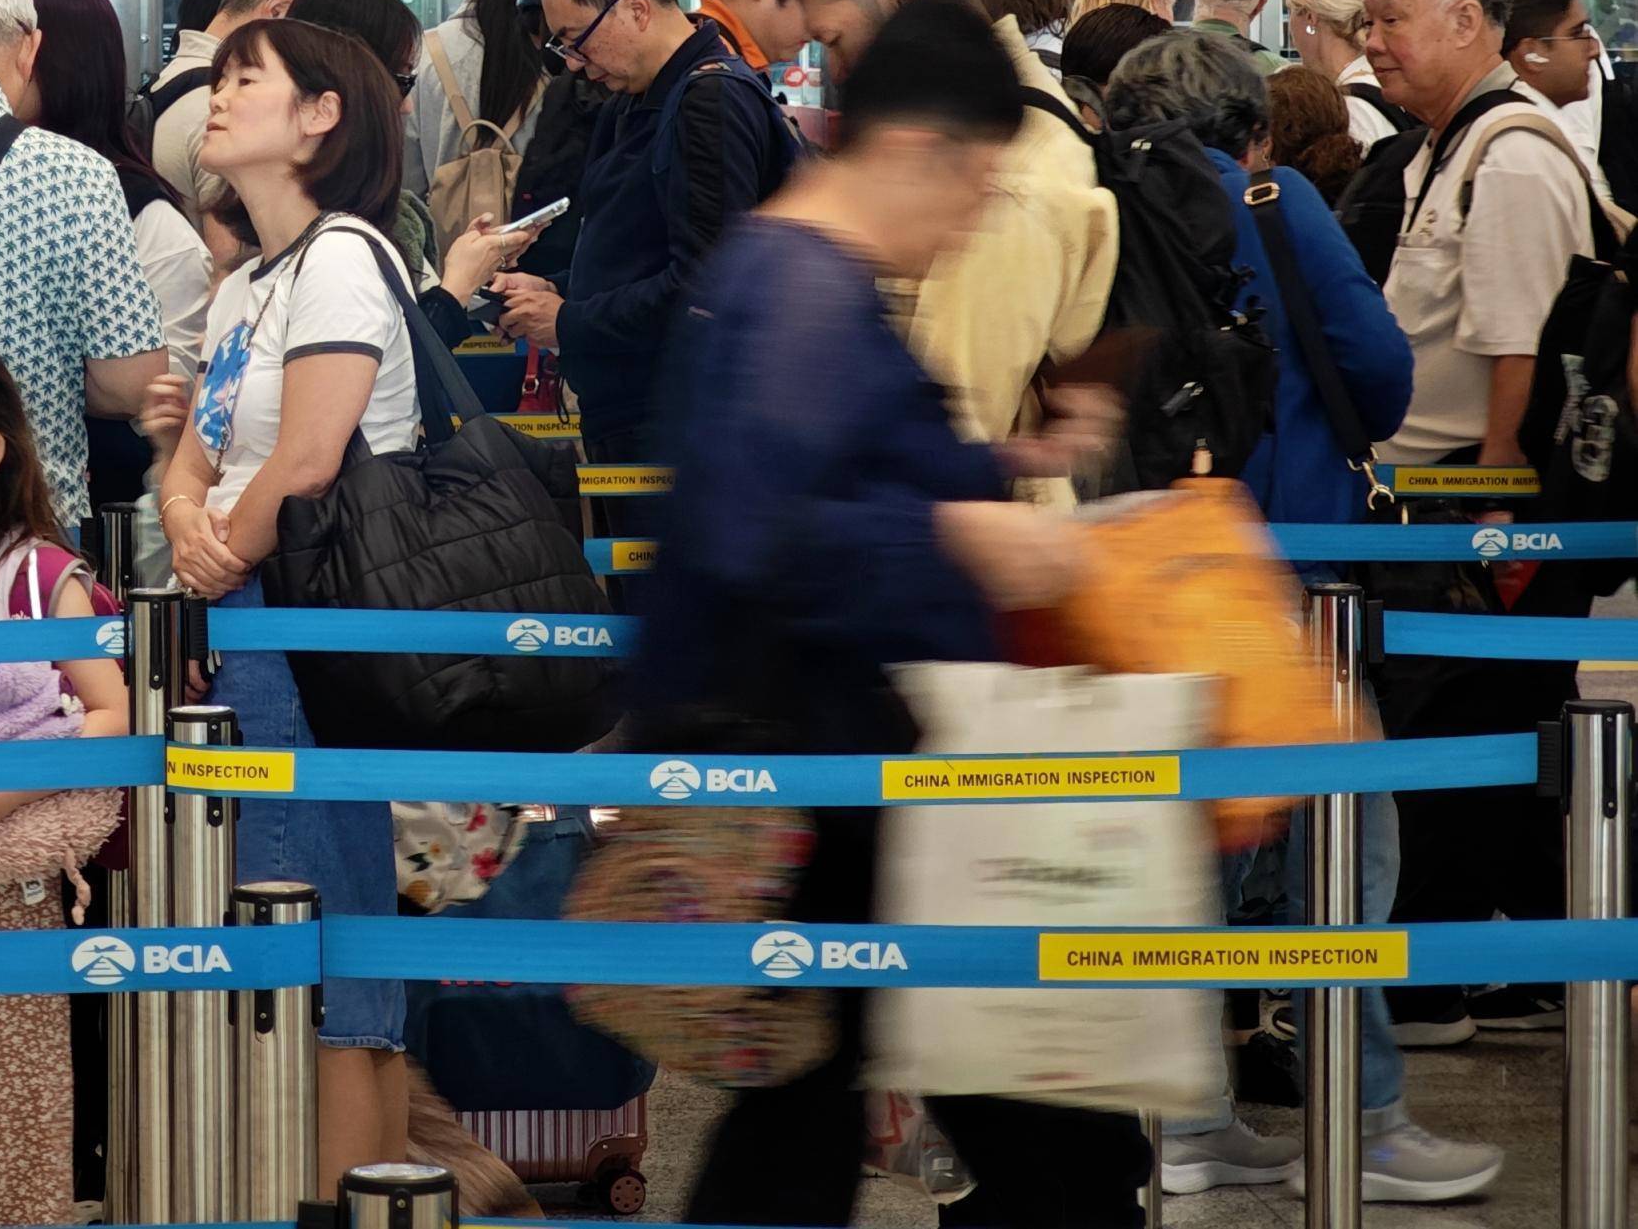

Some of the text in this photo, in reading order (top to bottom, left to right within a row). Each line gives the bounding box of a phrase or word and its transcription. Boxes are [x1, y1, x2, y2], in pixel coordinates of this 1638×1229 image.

[1408, 476, 1438, 485] CHINA
[1442, 476, 1509, 486] IMMIGRATION
[1512, 533, 1563, 551] BCIA
[554, 626, 612, 646] BCIA
[182, 763, 269, 779] INSPECTION
[706, 768, 777, 792] BCIA
[904, 770, 1155, 788] CHINA IMMIGRATION INSPECTION
[143, 944, 232, 974] BCIA
[821, 941, 908, 970] BCIA
[1067, 948, 1378, 967] CHINA IMMIGRATION INSPECTION
